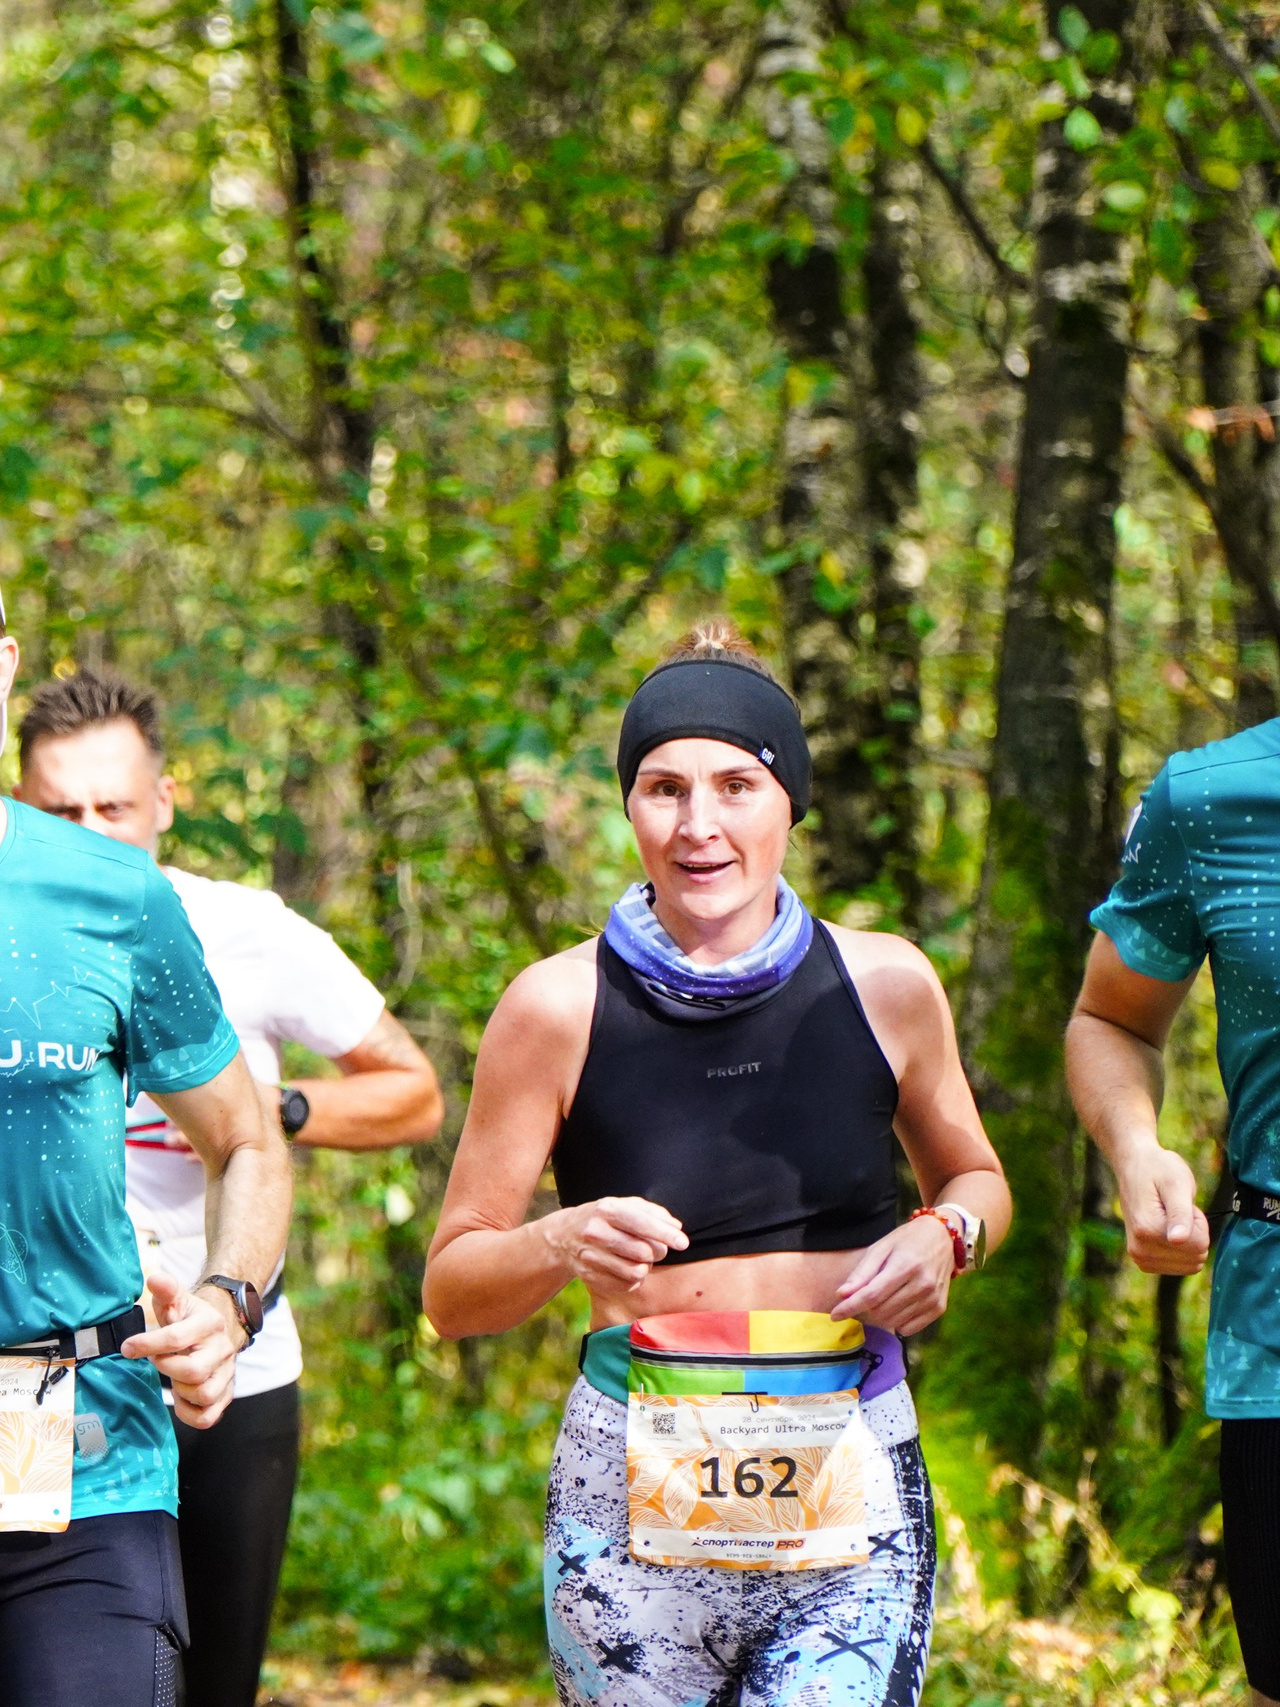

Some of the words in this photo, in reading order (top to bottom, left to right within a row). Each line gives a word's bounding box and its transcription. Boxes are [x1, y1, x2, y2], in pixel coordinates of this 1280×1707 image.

[761, 747, 775, 766] GRI
[706, 1061, 762, 1079] PROFIT
[0, 1378, 19, 1386] 2024
[12, 1387, 52, 1396] Moscw
[741, 1416, 752, 1424] 28
[720, 1425, 770, 1438] Backyard
[774, 1423, 806, 1434] Ultra
[811, 1422, 848, 1432] Moscow
[700, 1456, 799, 1499] 162
[777, 1539, 805, 1549] PRO
